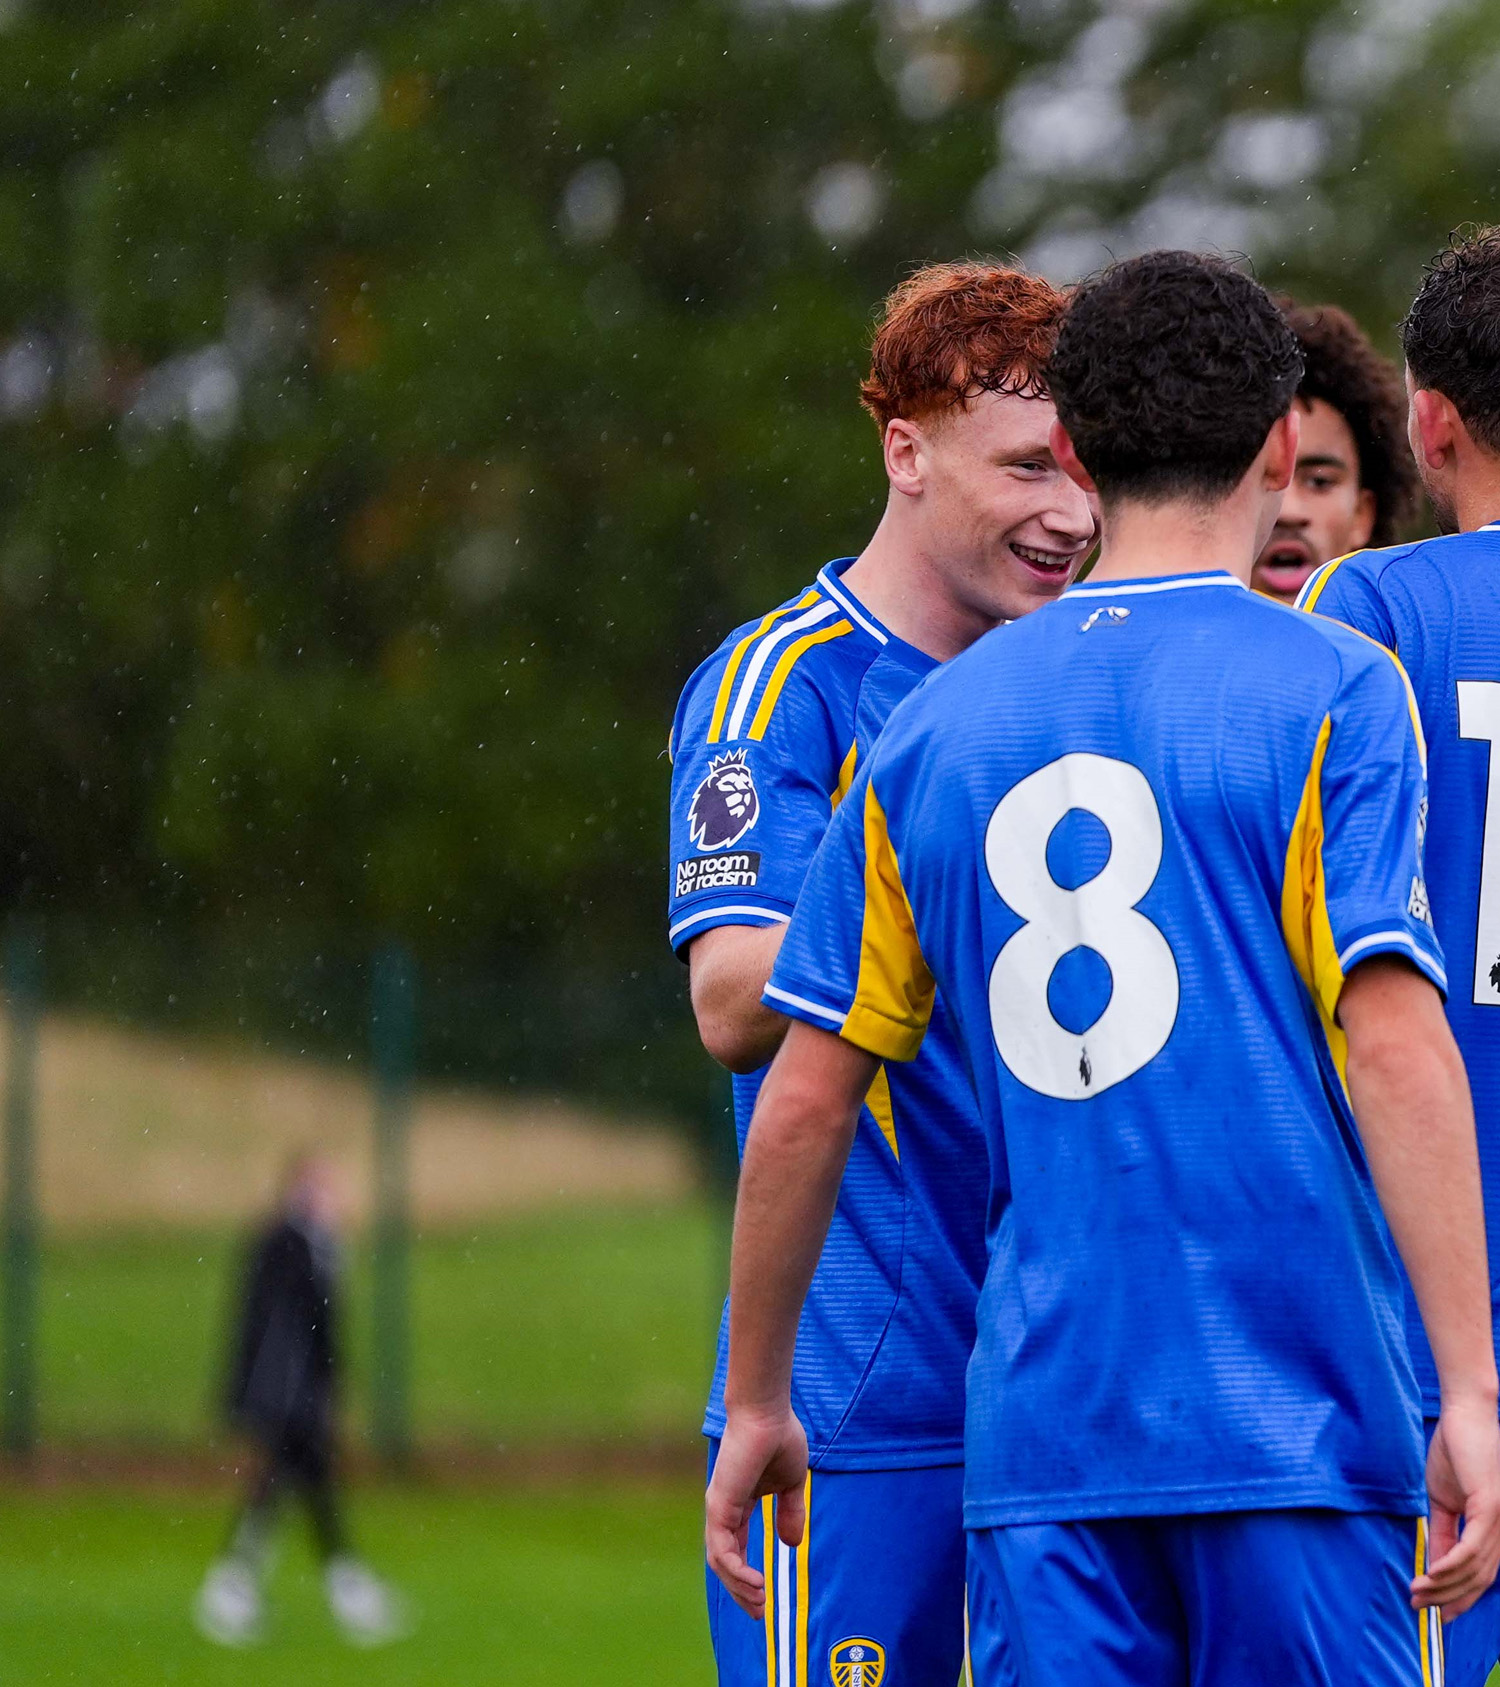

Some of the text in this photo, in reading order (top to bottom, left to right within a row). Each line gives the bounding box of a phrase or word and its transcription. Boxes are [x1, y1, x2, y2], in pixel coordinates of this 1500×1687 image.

[677, 855, 749, 878] No room
[695, 871, 757, 890] racism
[984, 751, 1180, 1101] 8
